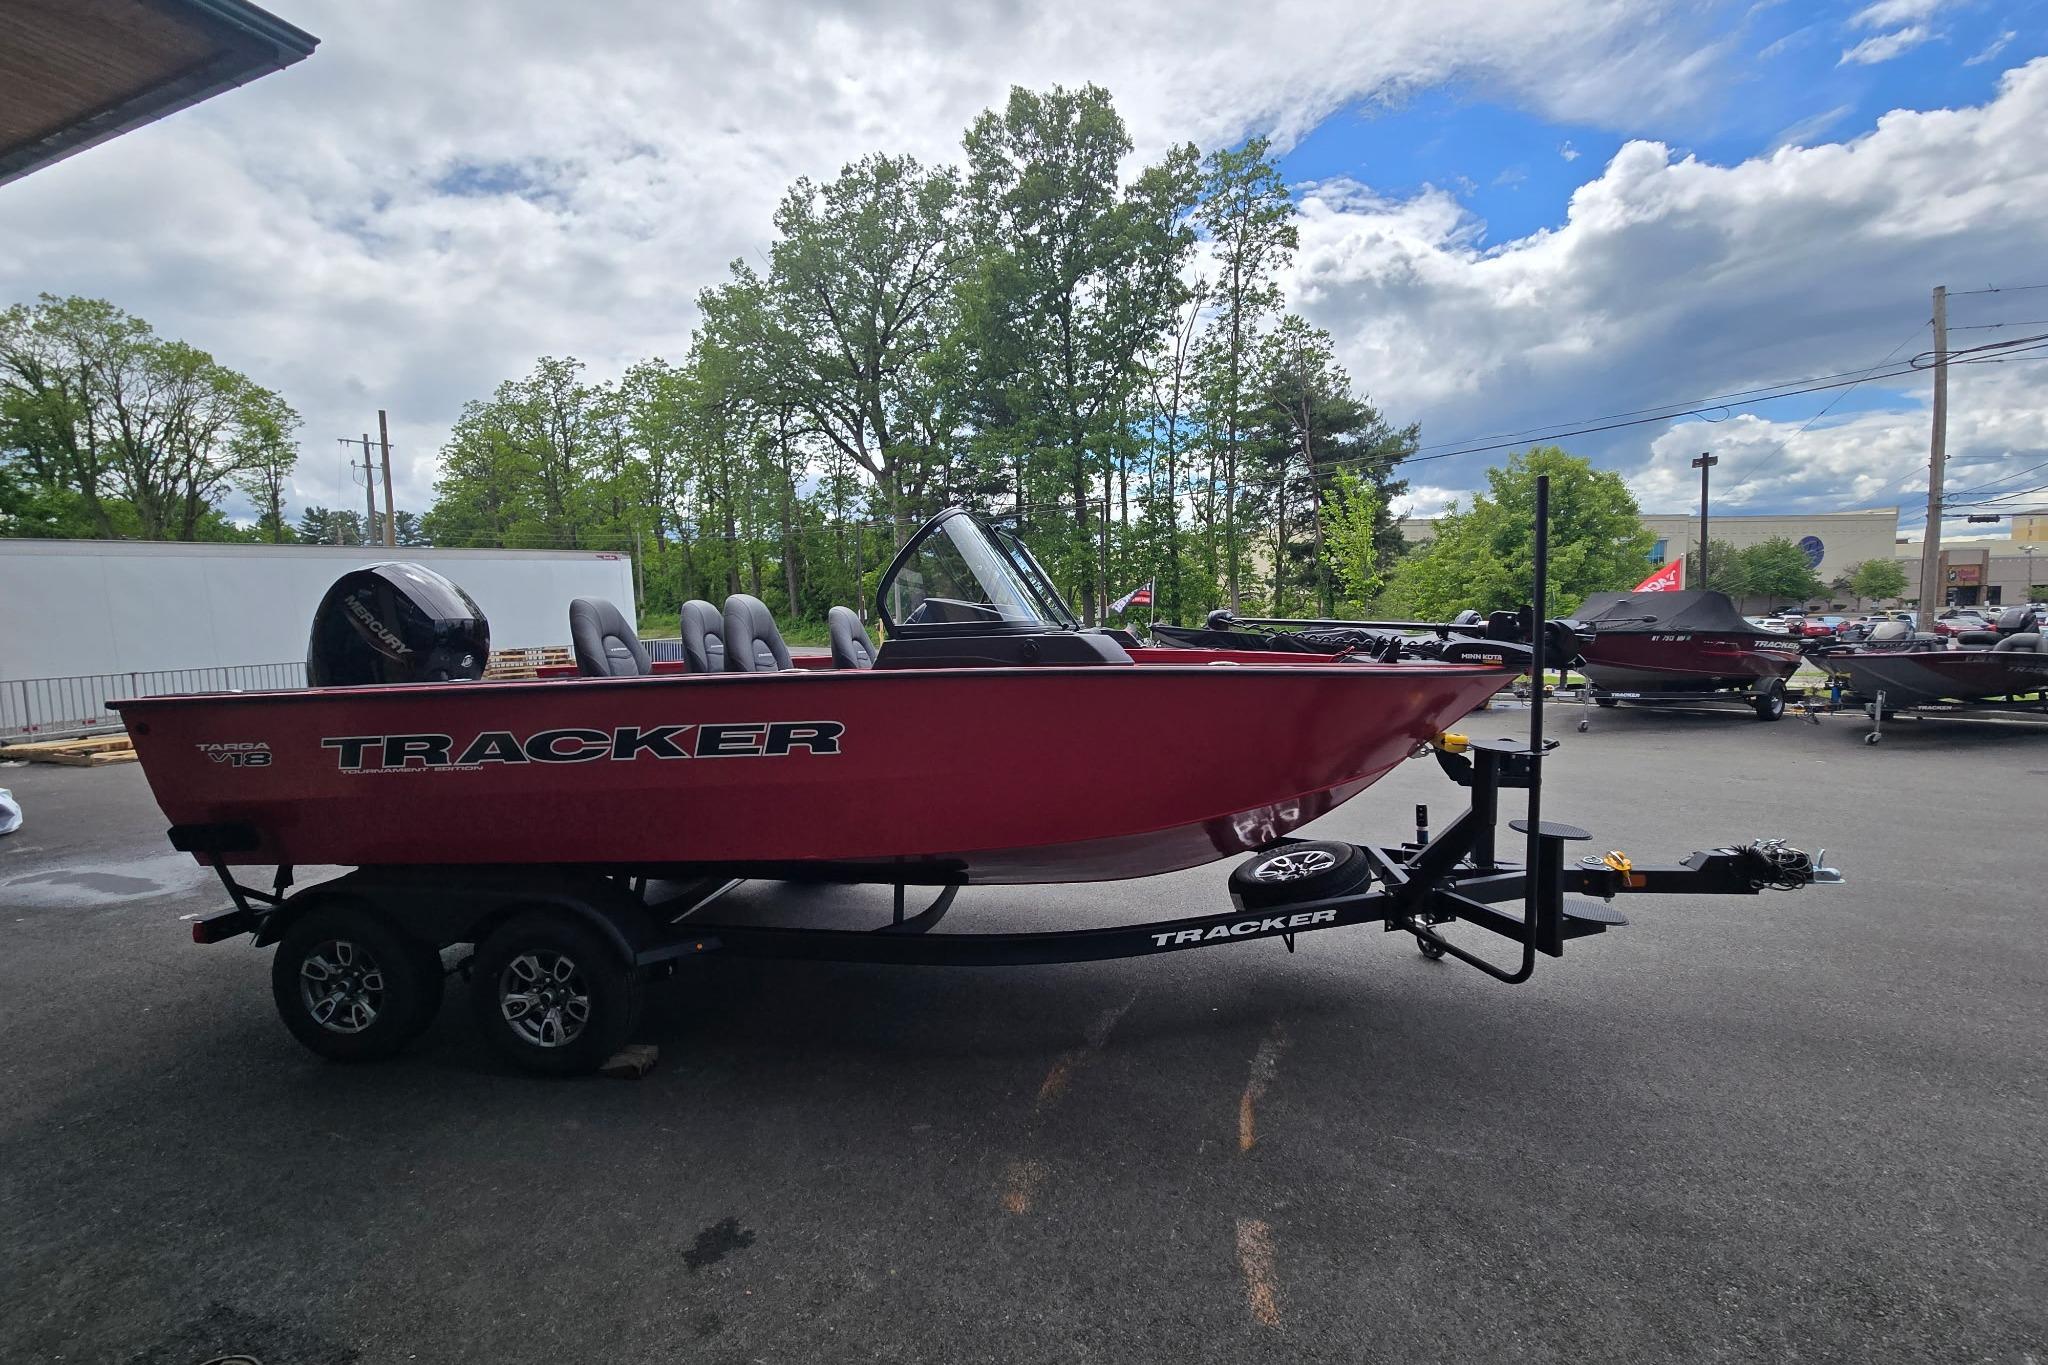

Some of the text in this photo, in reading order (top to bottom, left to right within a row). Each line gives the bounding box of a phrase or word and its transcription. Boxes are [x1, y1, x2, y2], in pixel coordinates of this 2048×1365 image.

[344, 594, 413, 654] MERCURY
[1754, 640, 1800, 650] TRACKER
[1482, 653, 1503, 661] KOTA
[196, 742, 271, 752] TARGA
[320, 721, 846, 769] TRACKER
[208, 751, 273, 768] V18
[341, 765, 485, 775] TOURNAMENT EDITION
[1151, 909, 1337, 946] TRACKER
